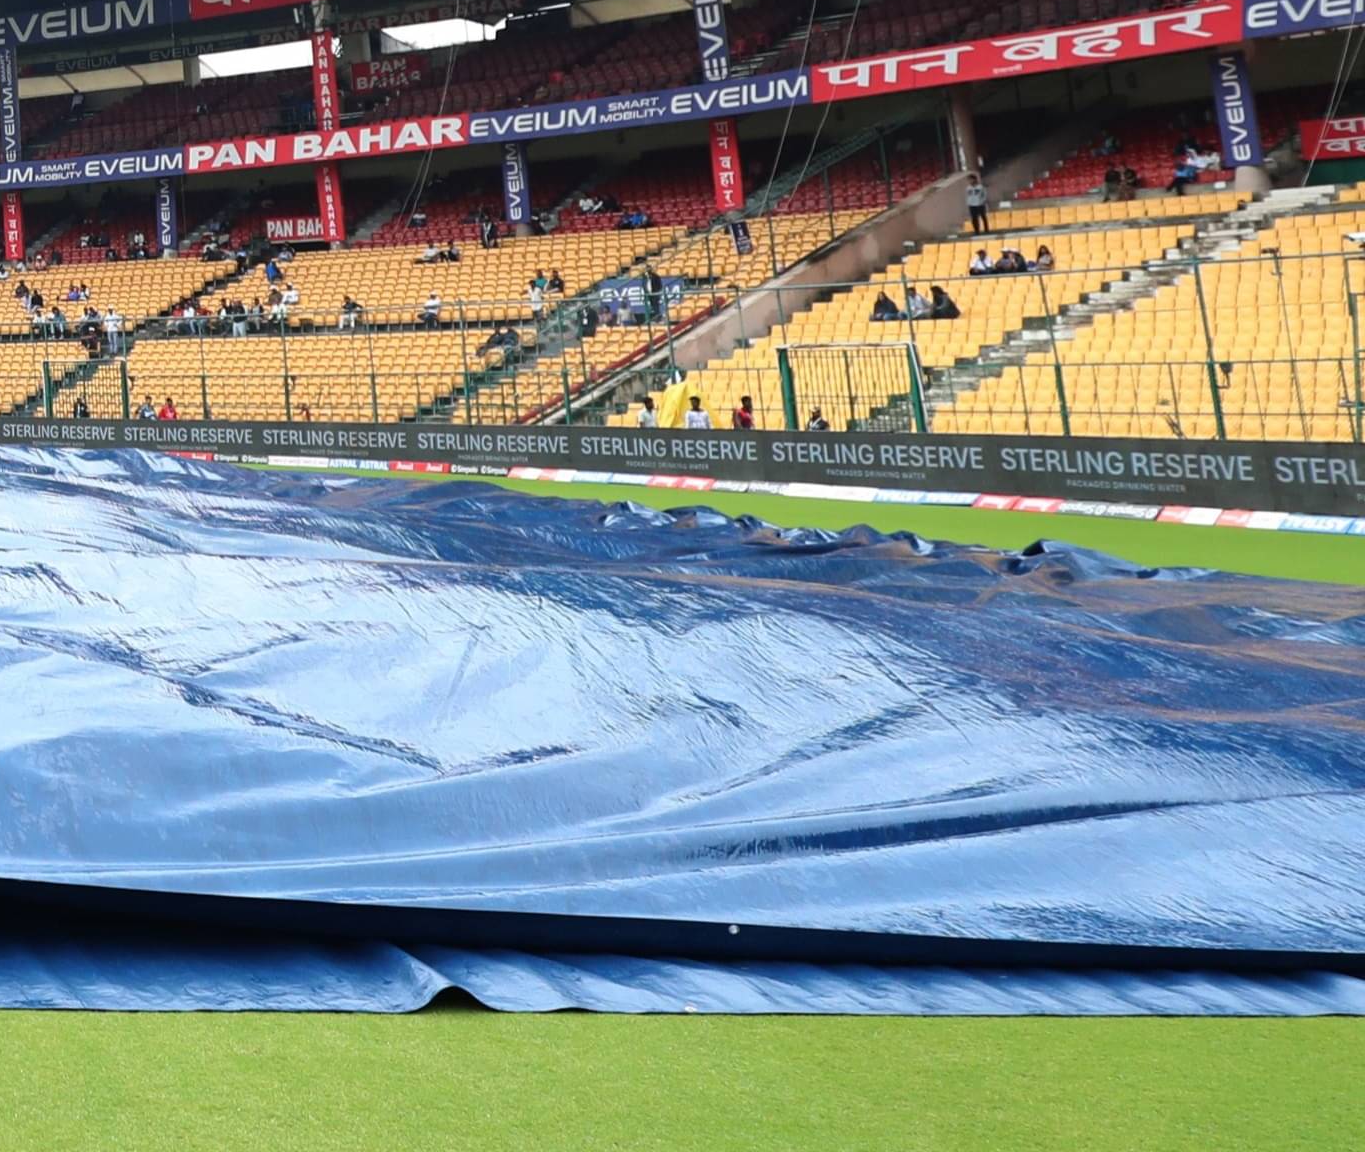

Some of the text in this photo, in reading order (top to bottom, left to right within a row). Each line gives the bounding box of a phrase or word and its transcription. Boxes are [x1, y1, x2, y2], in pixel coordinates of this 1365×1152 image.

[818, 46, 974, 89] पान
[607, 97, 660, 112] SMART
[670, 75, 809, 115] EVEIUM
[469, 104, 597, 138] EVEIUM
[599, 106, 666, 123] MOBILITY
[188, 118, 462, 169] PAN BAHAR
[41, 163, 76, 173] SMART
[84, 152, 183, 177] EVEIUM
[34, 170, 83, 182] MOBILITY
[267, 221, 294, 237] PAN
[3, 424, 59, 438] STERLING
[62, 425, 115, 440] RESERVE
[124, 427, 187, 442] STERLING
[192, 428, 253, 444] RESERVE
[264, 430, 333, 446] STERLING
[338, 432, 407, 448] RESERVE
[418, 432, 492, 453] STERLING
[497, 434, 569, 454] RESERVE
[581, 436, 667, 457] STERLING
[672, 439, 757, 460] RESERVE
[772, 441, 874, 465] STERLING
[881, 445, 984, 469] RESERVE
[1001, 448, 1125, 476] STERLING
[1131, 453, 1255, 481] RESERVE
[1067, 480, 1186, 493] PACKAGED DRINKING WATER
